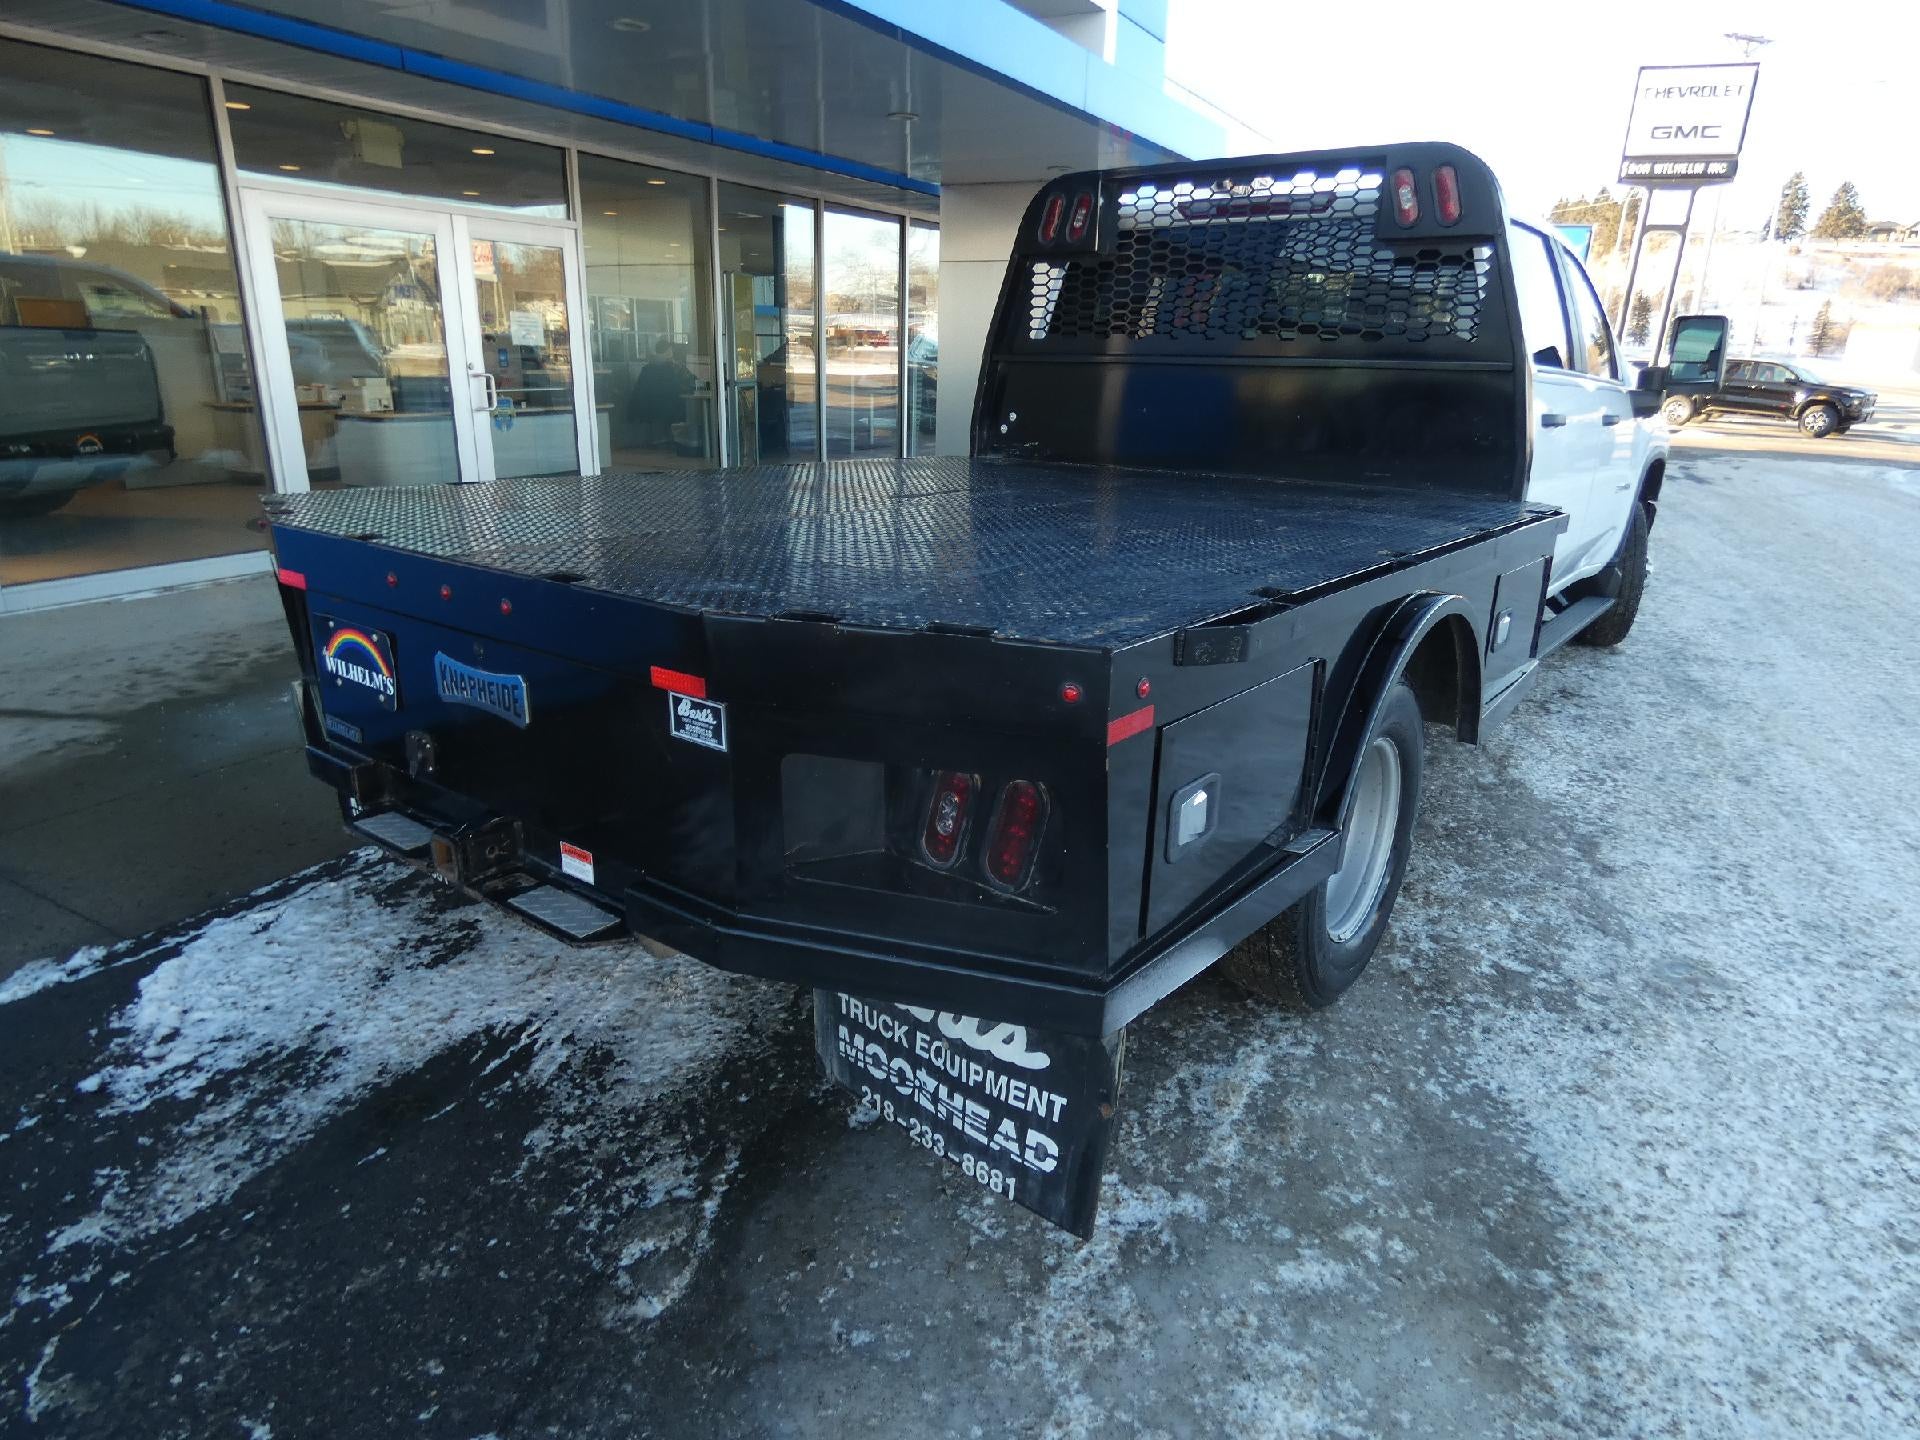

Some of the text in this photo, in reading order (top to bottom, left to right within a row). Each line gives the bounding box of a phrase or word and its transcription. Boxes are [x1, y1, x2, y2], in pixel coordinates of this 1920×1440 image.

[1644, 84, 1745, 99] CHEVROLET
[1650, 125, 1722, 140] GMC
[324, 653, 395, 696] WILHELM'S
[438, 660, 523, 719] KNAPHEIDE
[837, 992, 910, 1049] TRUCK
[915, 1030, 1068, 1123] EQUIPMENT
[838, 1025, 1059, 1174] MOORHEAD
[861, 1085, 1017, 1201] 218-233-8681
